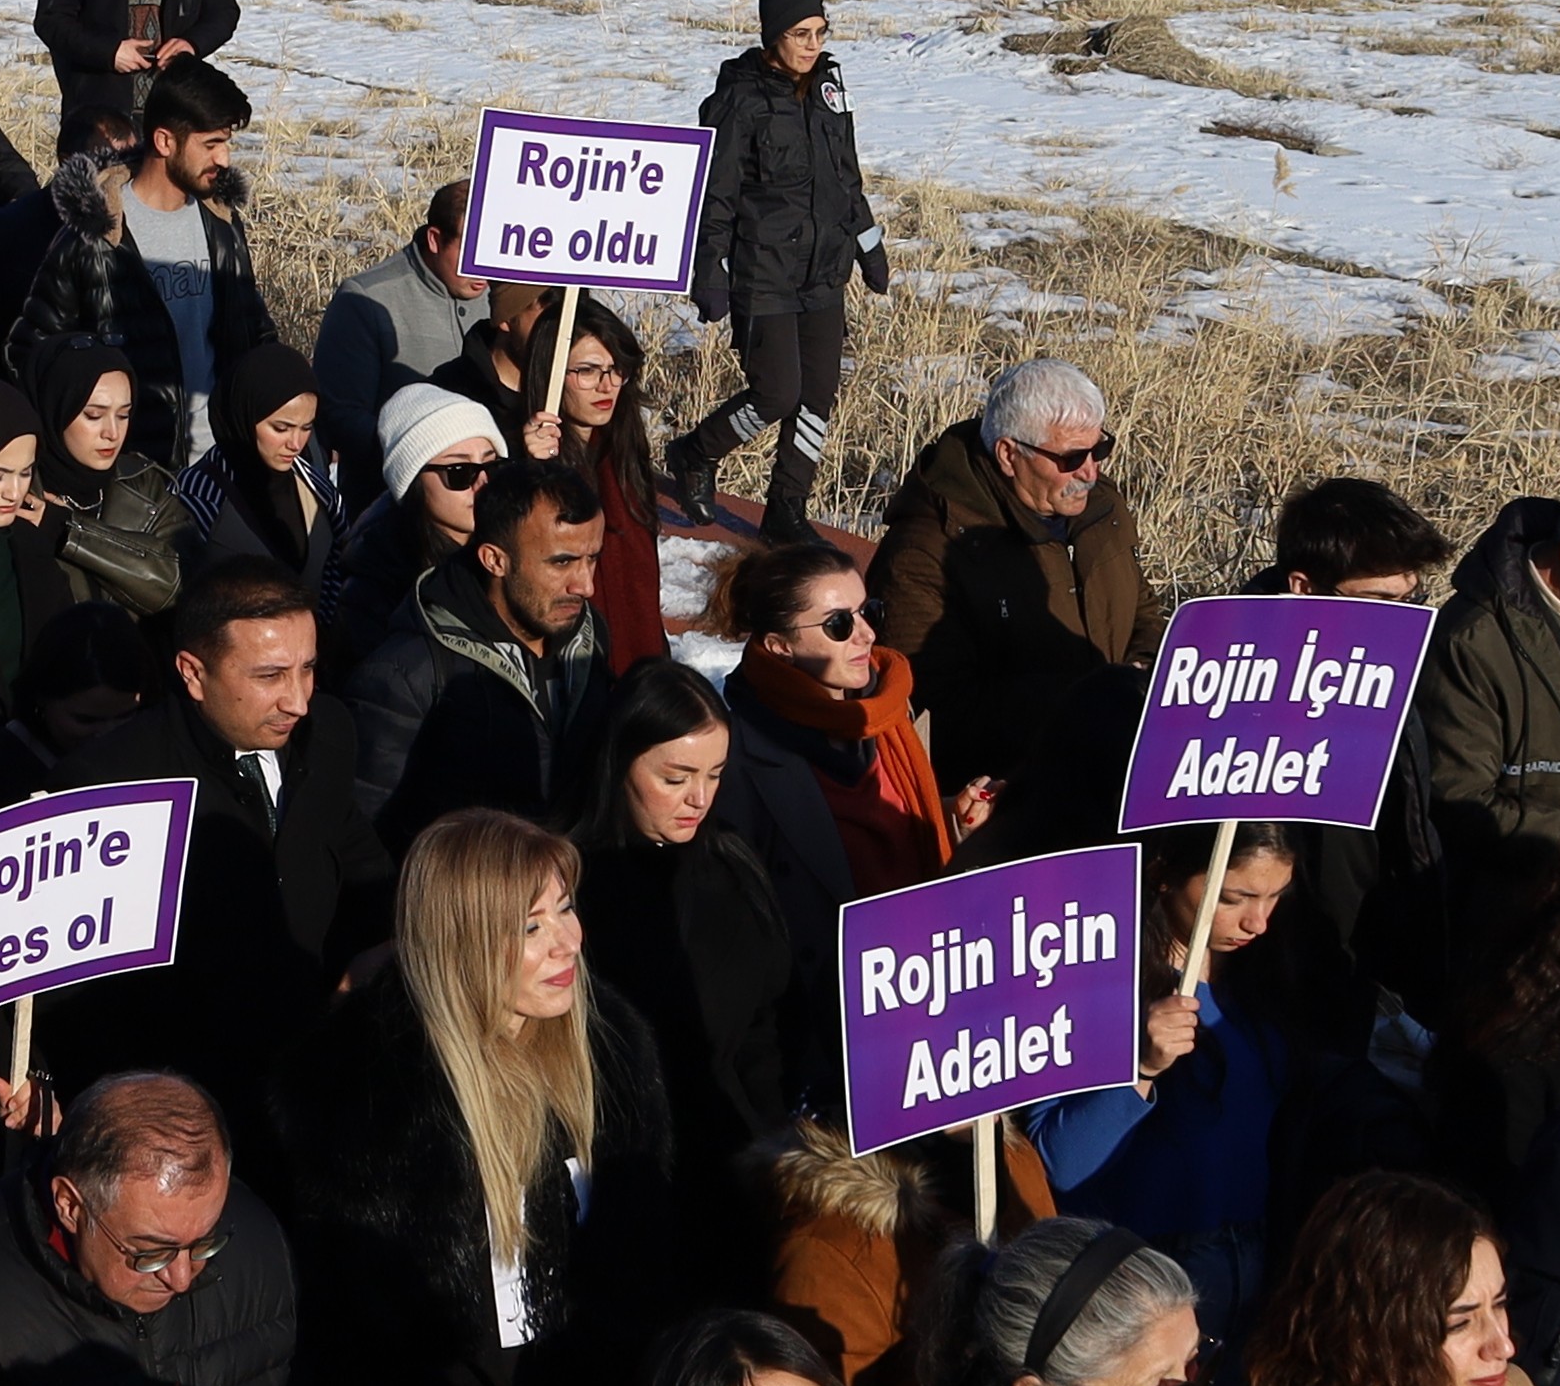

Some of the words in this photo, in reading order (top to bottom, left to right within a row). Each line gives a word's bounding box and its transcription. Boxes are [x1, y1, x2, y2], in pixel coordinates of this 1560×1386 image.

[516, 141, 664, 202] Rojin'e
[499, 222, 554, 260] ne
[568, 219, 659, 266] oldu
[1160, 644, 1279, 719] Rojin
[1288, 630, 1395, 718] İçin
[1166, 736, 1330, 799] Adalet
[67, 896, 114, 951] ol
[861, 928, 995, 1017] Rojin
[1011, 896, 1117, 988] İçin
[902, 1004, 1073, 1110] Adalet
